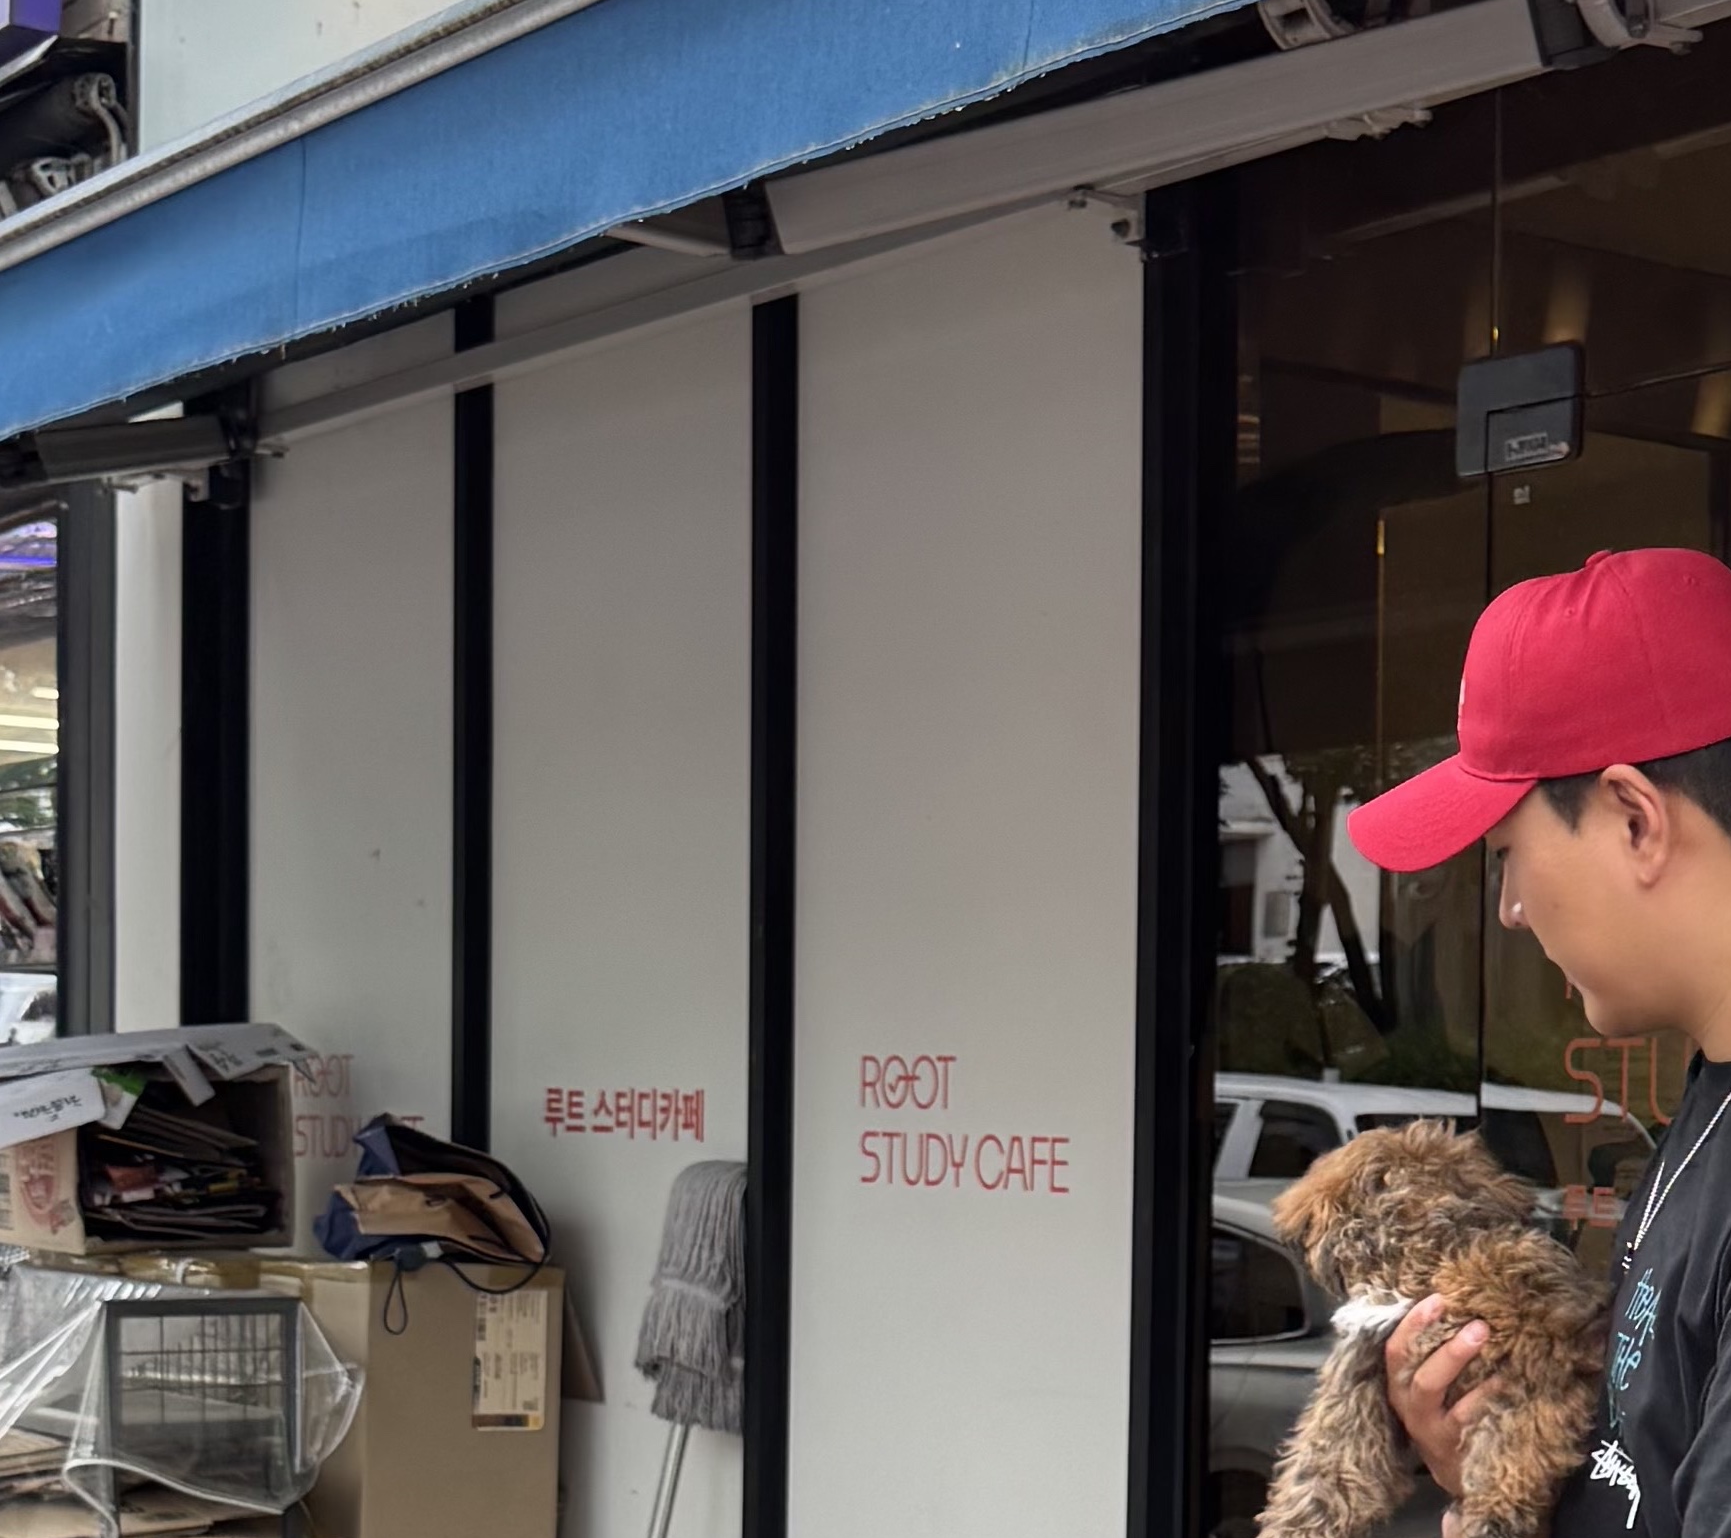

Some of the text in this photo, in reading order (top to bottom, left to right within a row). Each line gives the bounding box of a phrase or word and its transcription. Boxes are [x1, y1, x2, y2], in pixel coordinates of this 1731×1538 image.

[860, 1054, 958, 1111] ROOT
[1563, 1036, 1690, 1126] STU
[543, 1086, 705, 1143] 루트 스터디카페
[860, 1130, 1071, 1194] STUDY CAFE
